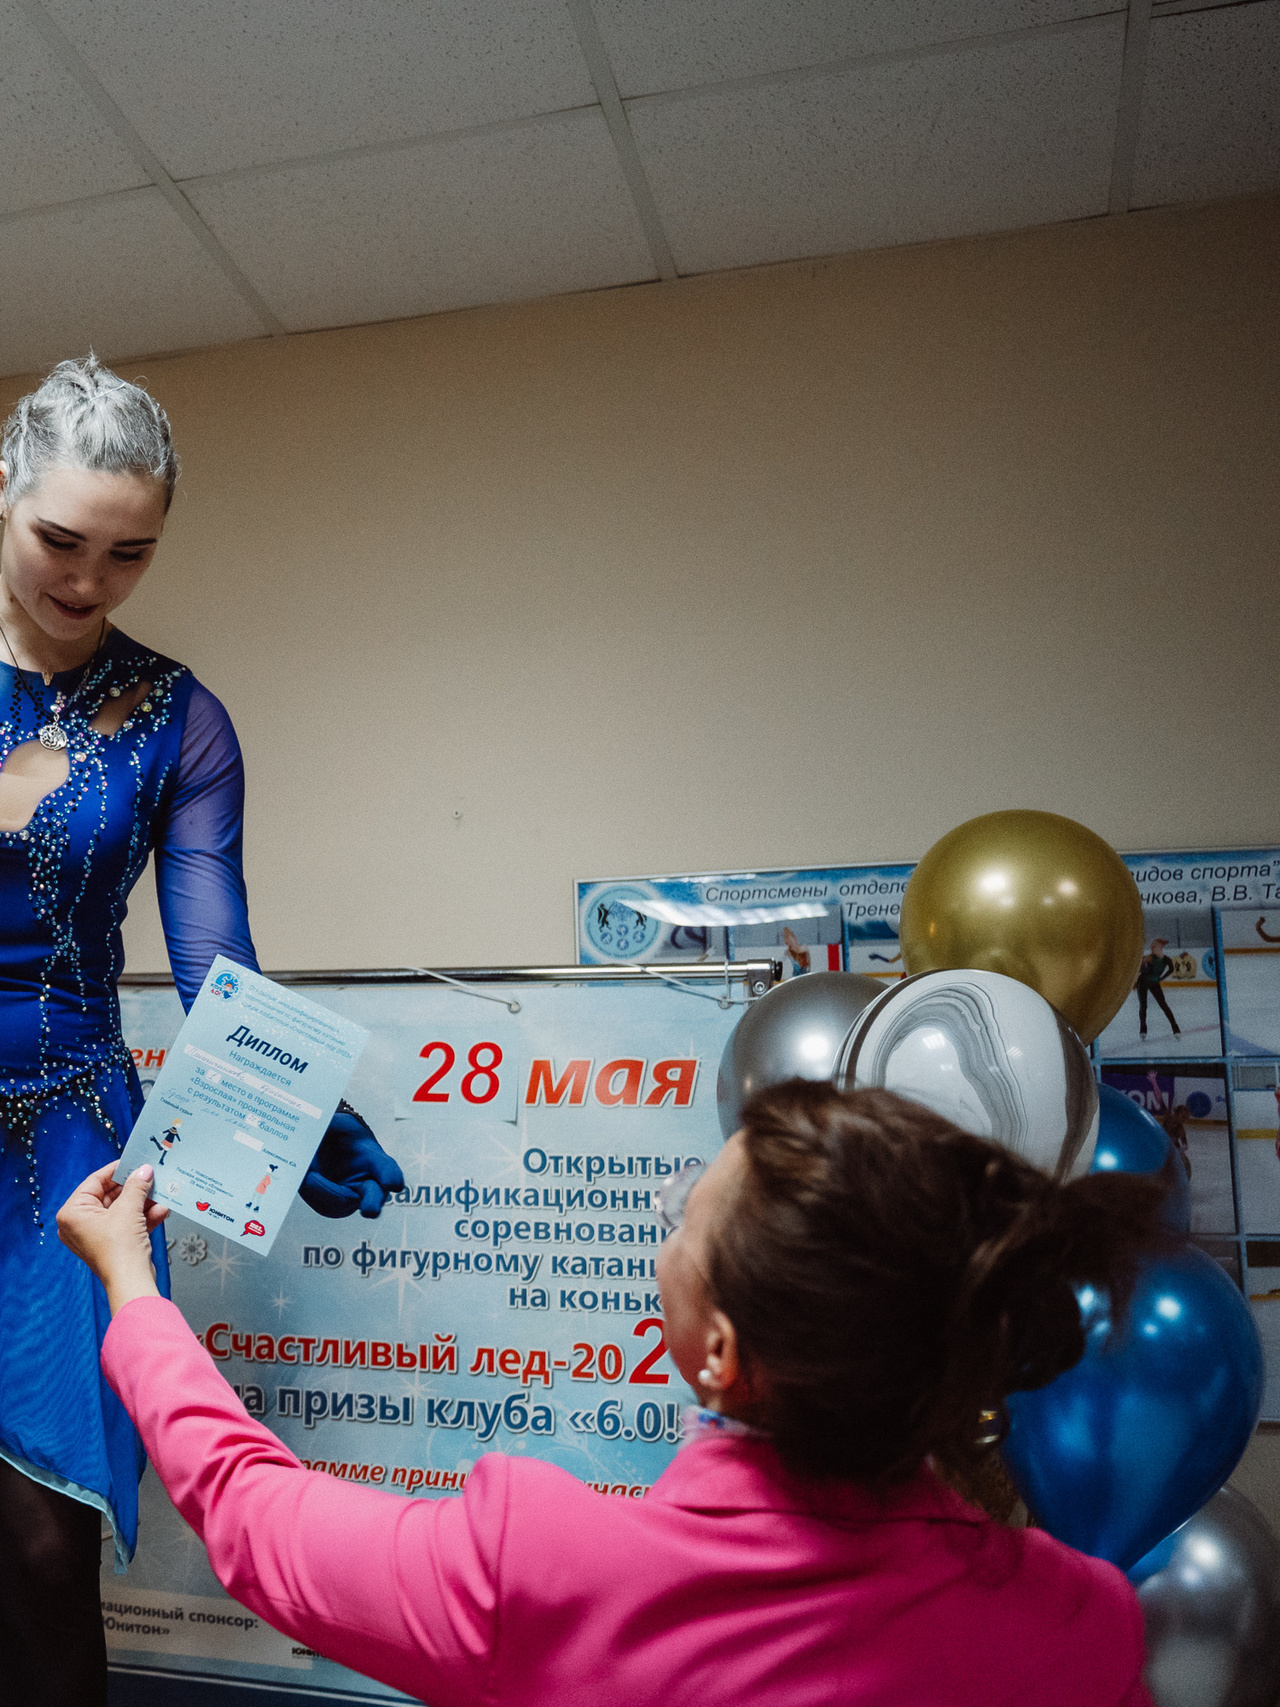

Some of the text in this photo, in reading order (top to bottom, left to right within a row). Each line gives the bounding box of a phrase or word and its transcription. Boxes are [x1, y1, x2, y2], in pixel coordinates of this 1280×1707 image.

[1132, 866, 1183, 882] идов
[706, 885, 828, 903] Спортсмены
[1212, 886, 1253, 901] В.В.
[225, 1024, 308, 1073] Диплом
[227, 1049, 292, 1087] Награждается
[412, 1041, 698, 1106] 28 мая
[189, 1076, 295, 1132] «Взрослая» произвольная
[194, 1066, 205, 1075] за
[220, 1079, 246, 1096] место
[253, 1095, 300, 1123] программе
[192, 1090, 246, 1120] результатом
[259, 1121, 289, 1141] баллов
[386, 1180, 659, 1213] алификационн
[209, 1207, 234, 1222] ЮНИТОН
[303, 1245, 342, 1266] по
[353, 1242, 540, 1280] фигурному
[509, 1286, 662, 1312] на коньк
[279, 1388, 411, 1427] призы
[427, 1394, 554, 1439] клуба
[587, 1483, 652, 1498] час
[189, 1612, 258, 1630] спонсор:
